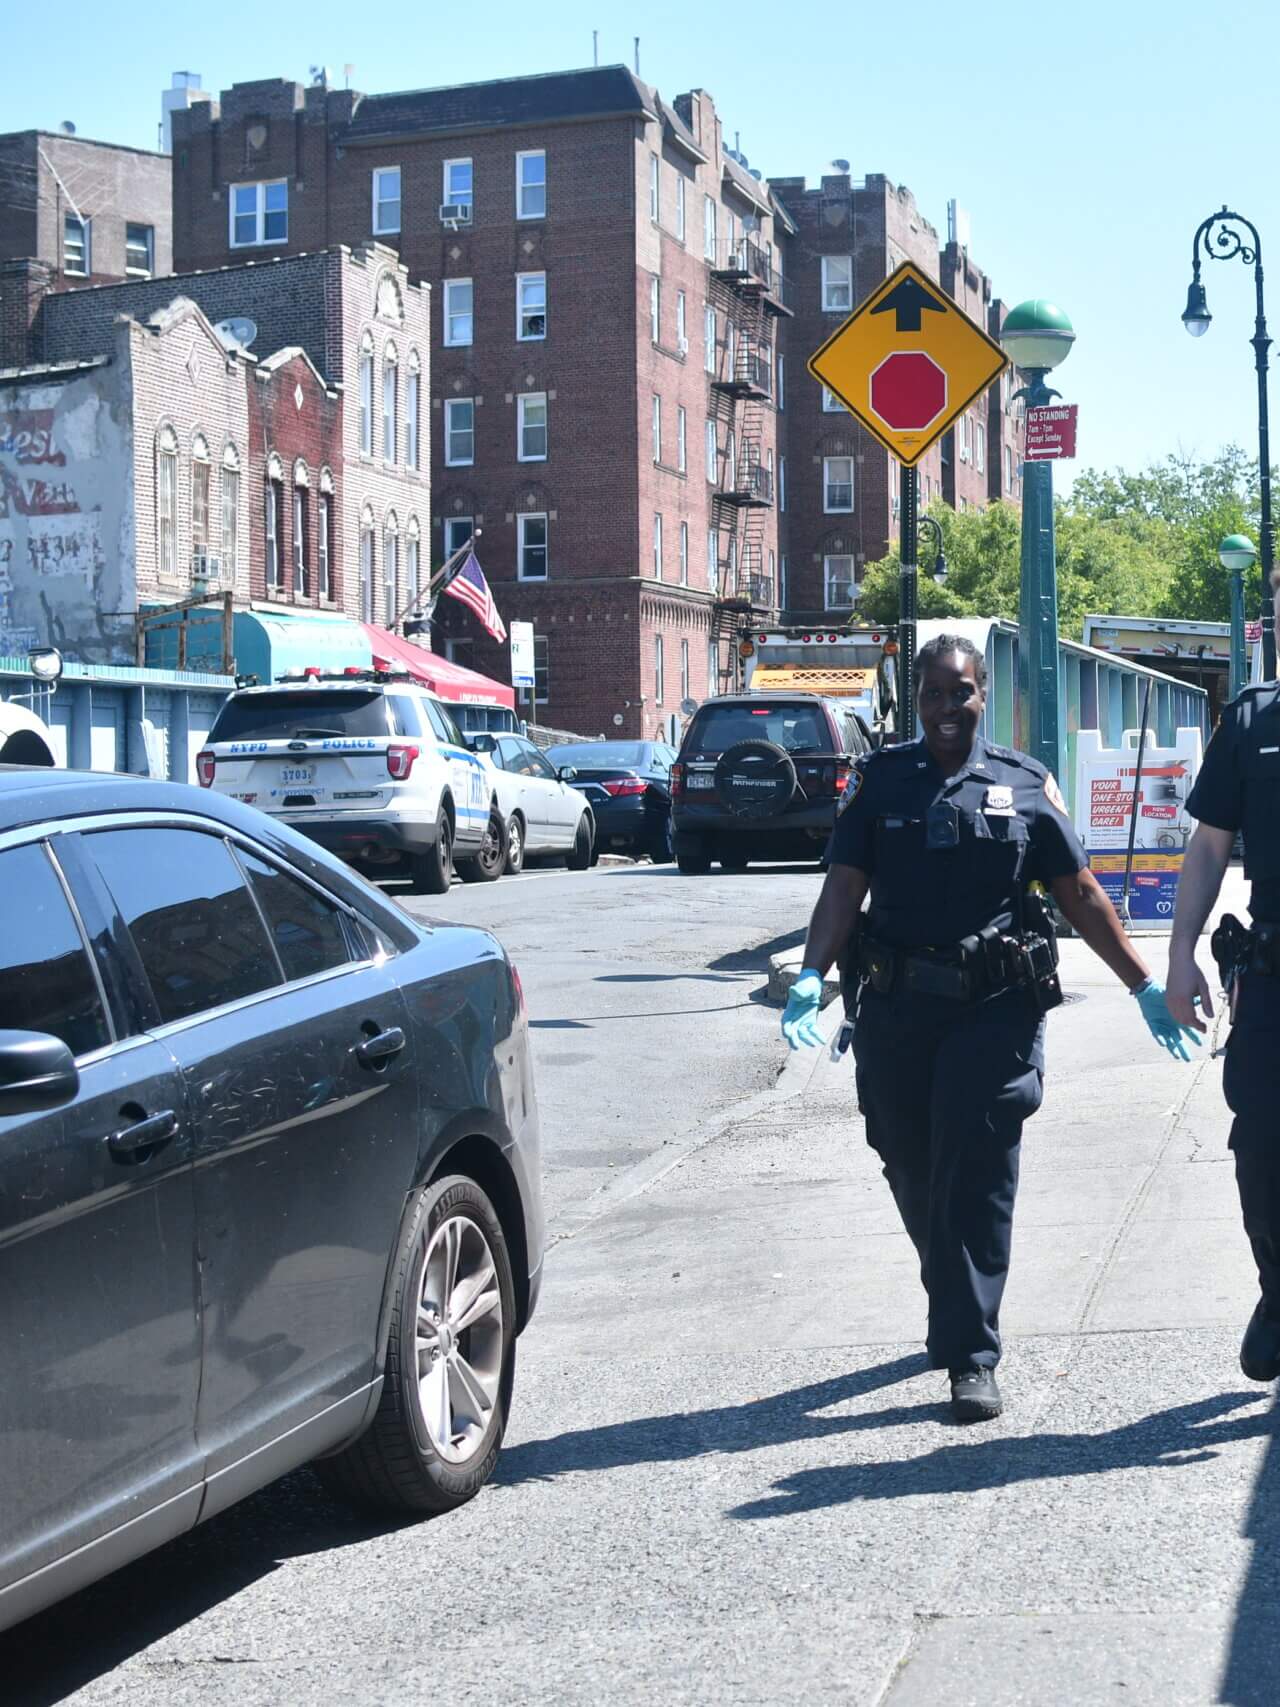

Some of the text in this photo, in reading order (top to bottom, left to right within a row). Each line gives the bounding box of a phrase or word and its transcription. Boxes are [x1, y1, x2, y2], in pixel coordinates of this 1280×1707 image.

[1029, 410, 1069, 421] NO STANDING
[1027, 433, 1062, 444] Except Sunday
[230, 743, 268, 753] NYPD
[322, 739, 376, 750] POLICE
[282, 769, 307, 780] 3703
[1092, 781, 1118, 790] YOUR
[1092, 793, 1139, 802] ONE-STO
[1092, 805, 1130, 814] URGENT
[1091, 817, 1120, 826] CARE!
